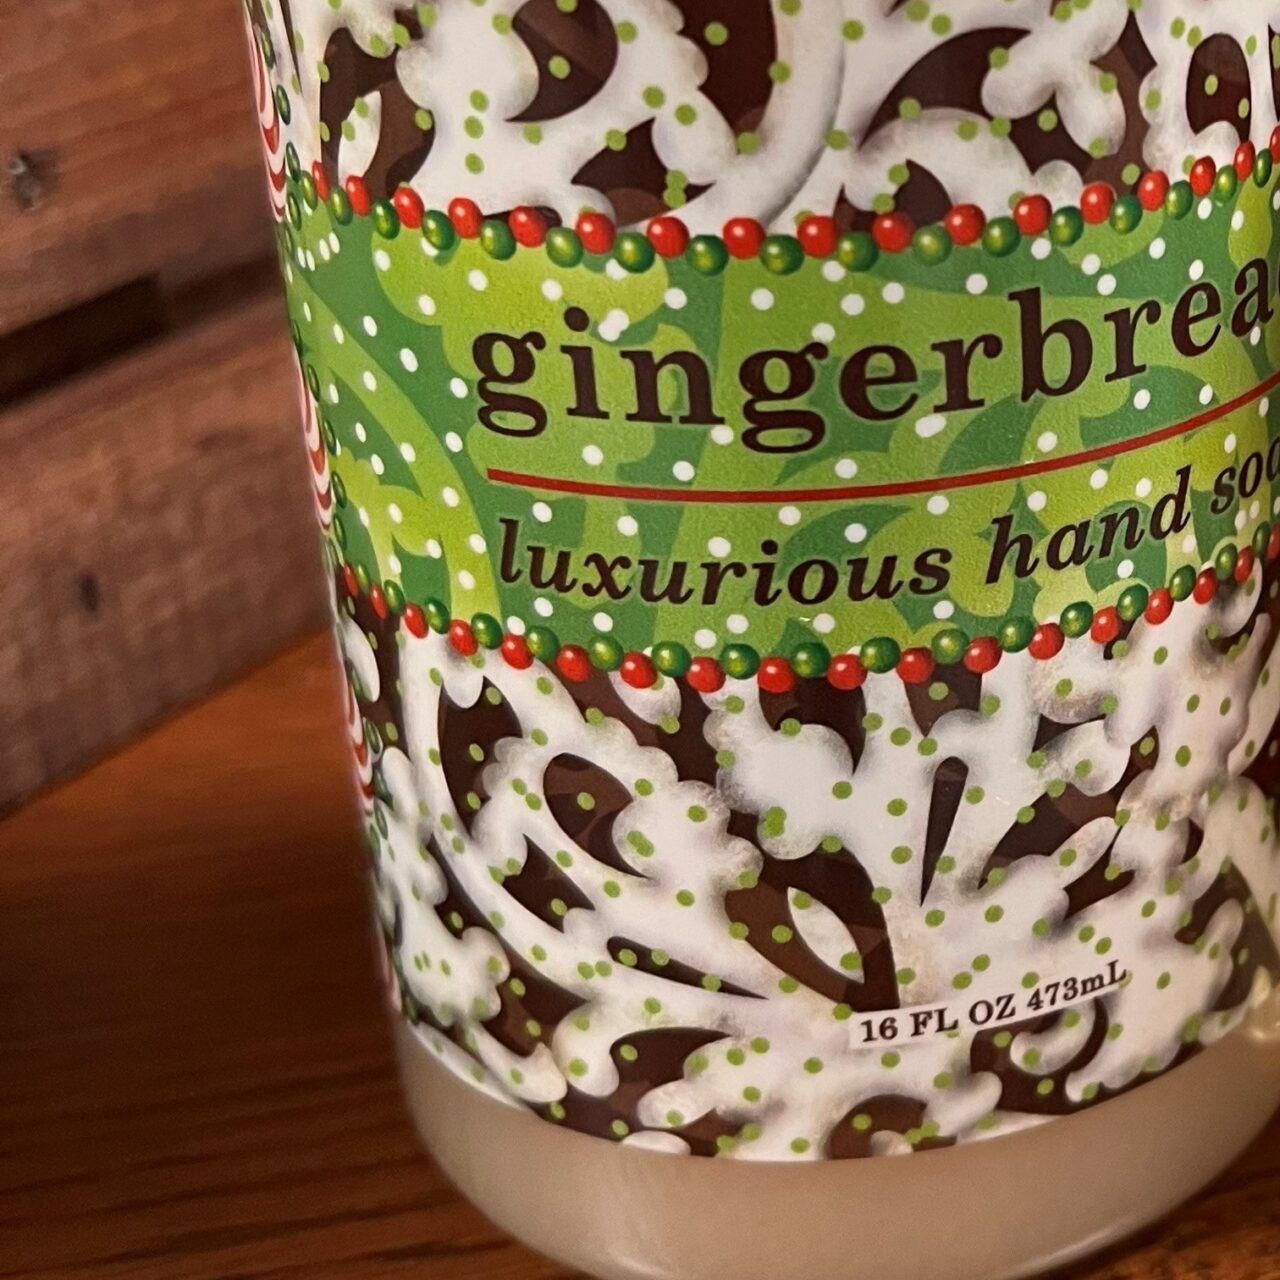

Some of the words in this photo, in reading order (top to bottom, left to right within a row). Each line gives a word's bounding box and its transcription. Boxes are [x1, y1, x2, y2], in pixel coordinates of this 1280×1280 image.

[499, 515, 951, 607] luxurious
[984, 463, 1192, 585] hand
[860, 1017, 899, 1043] 16
[909, 1007, 959, 1037] FL
[968, 992, 1016, 1026] OZ
[1026, 959, 1128, 1012] 473mL
